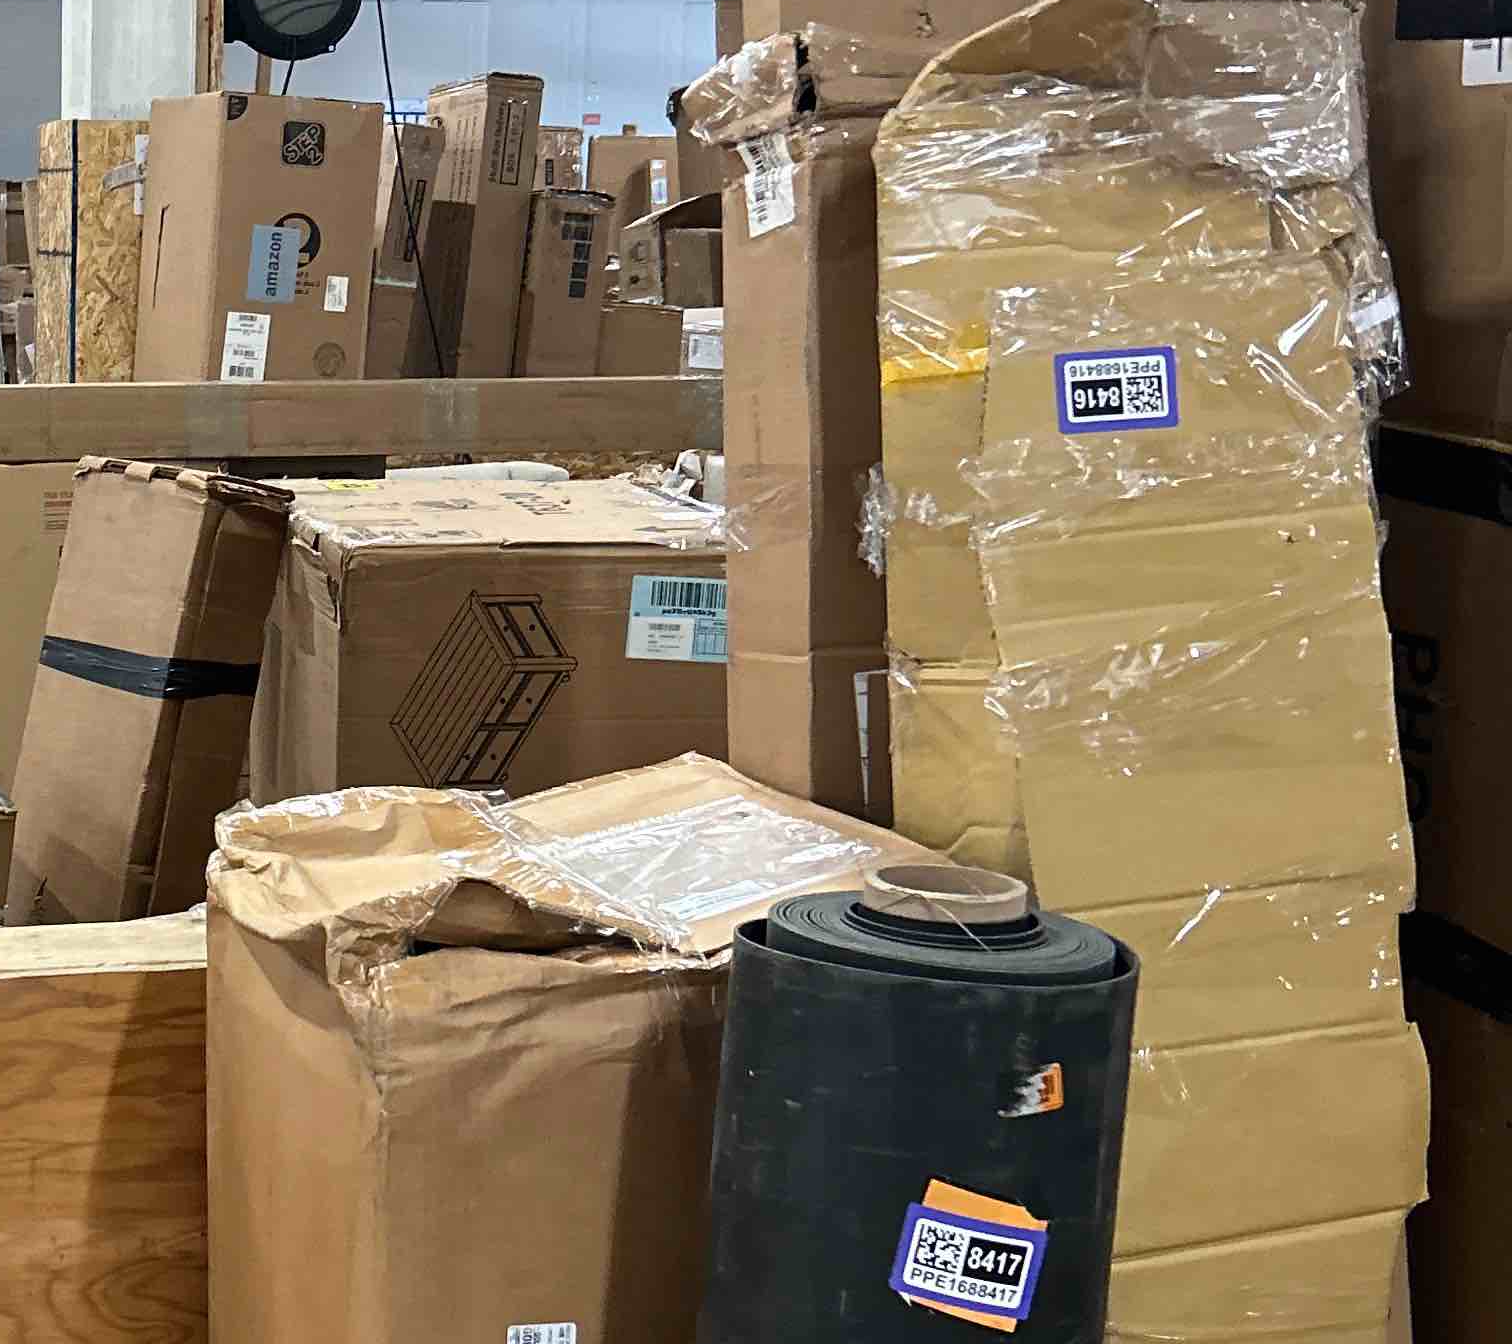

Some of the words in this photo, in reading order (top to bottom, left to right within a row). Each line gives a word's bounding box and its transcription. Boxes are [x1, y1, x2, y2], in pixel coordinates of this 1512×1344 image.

[265, 231, 283, 297] amazon
[1068, 359, 1161, 378] PPE1688416
[1073, 386, 1121, 410] 8416
[966, 1245, 1023, 1277] 8417
[909, 1267, 1018, 1304] PPE1688417
